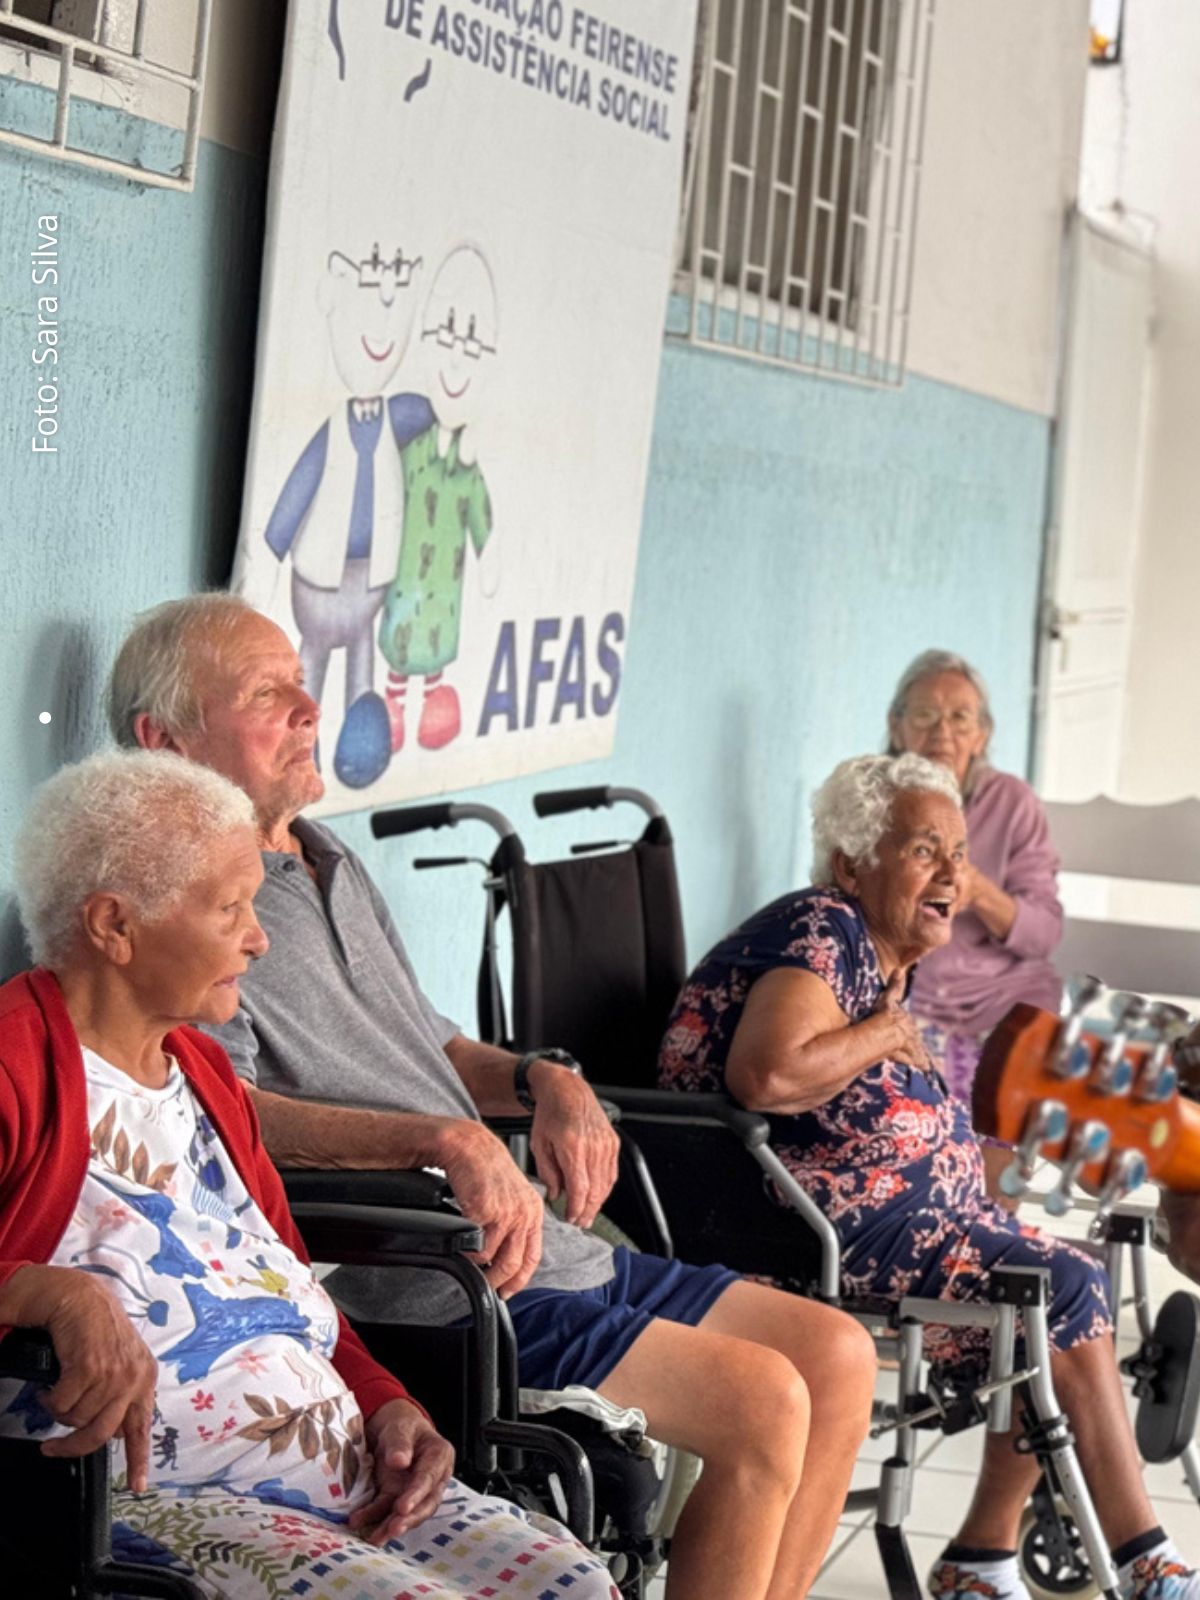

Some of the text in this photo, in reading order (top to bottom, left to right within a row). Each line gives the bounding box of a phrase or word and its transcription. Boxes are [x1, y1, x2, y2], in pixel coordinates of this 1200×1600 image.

[384, 0, 671, 142] DE ASSISTÊNCIA SOCIAL
[570, 8, 679, 93] FEIRENSE
[476, 611, 625, 737] AFAS
